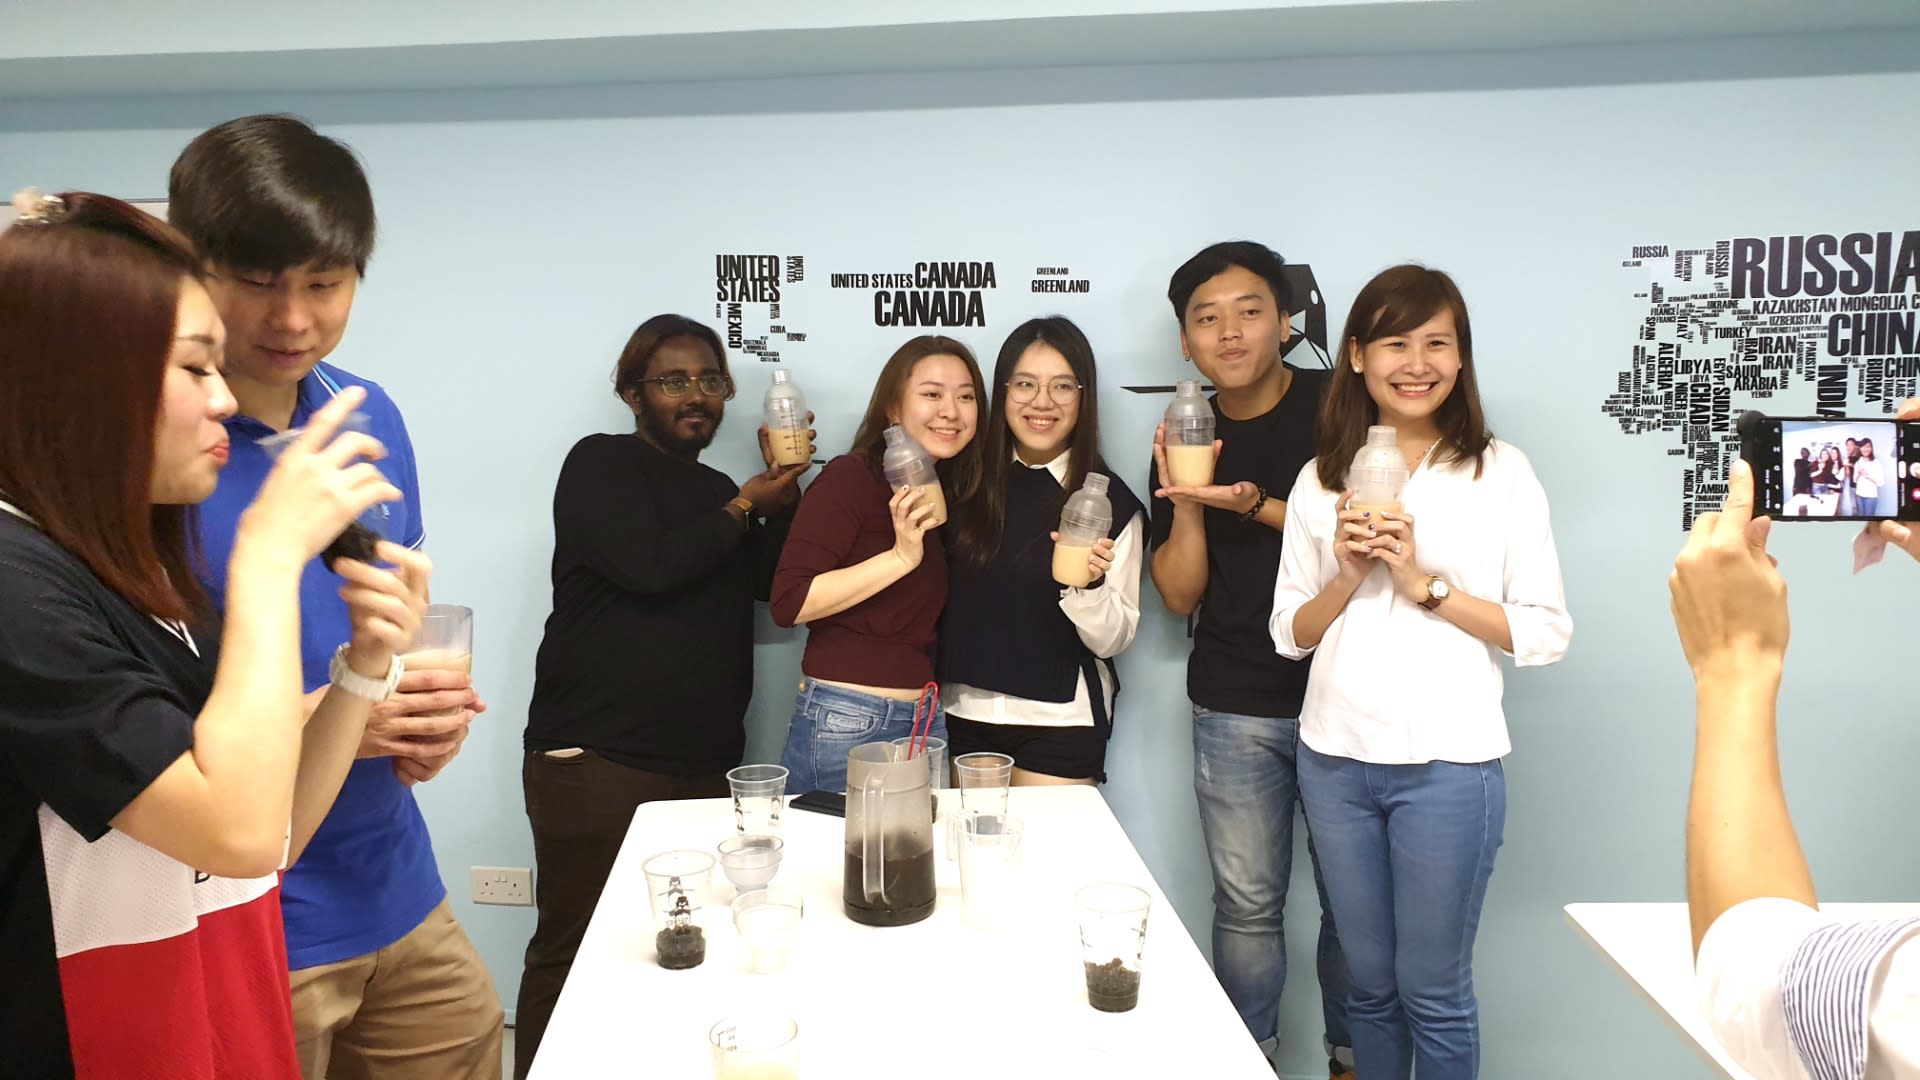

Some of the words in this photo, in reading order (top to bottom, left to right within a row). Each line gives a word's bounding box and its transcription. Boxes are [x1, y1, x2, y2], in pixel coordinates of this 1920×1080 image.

[1632, 245, 1669, 258] RUSSIA
[1705, 249, 1714, 275] FINLAND
[1714, 241, 1730, 278] RUSSIA
[716, 255, 780, 280] UNITED
[914, 262, 996, 289] CANADA
[1036, 267, 1069, 275] GREENLAND
[1674, 250, 1684, 278] NORWAY
[1683, 256, 1692, 281] SWEDEN
[1731, 231, 1920, 299] RUSSIA
[717, 279, 781, 302] STATES
[831, 273, 869, 288] UNITED
[872, 273, 913, 288] STATES
[1031, 279, 1090, 293] GREENLAND
[874, 291, 985, 327] CANADA
[1651, 307, 1676, 315] FRANCE
[1707, 300, 1739, 309] UKRAINE
[1753, 298, 1837, 314] KAZAKHSTAN
[1840, 294, 1908, 311] MONGOLIA
[728, 303, 742, 348] MEXICO
[770, 325, 786, 333] CUBA
[1645, 317, 1656, 340] SPAIN
[1676, 316, 1688, 340] ITALY
[1769, 314, 1822, 326] UZBEKISTAN
[1714, 327, 1752, 339] TURKEY
[1743, 338, 1758, 361] IRAQ
[1758, 336, 1797, 354] IRAN
[1646, 355, 1656, 384] ALGERIA
[1657, 343, 1674, 390] ALGERIA
[1675, 359, 1712, 374] LIBYA
[1713, 358, 1726, 386] EGYPT
[1726, 364, 1761, 379] SAUDI
[1763, 355, 1793, 370] IRAN
[1805, 341, 1817, 381] PAKISTAN
[1734, 377, 1778, 391] ARABIA
[1865, 359, 1883, 403] BURMA
[1895, 379, 1906, 397] LAOS
[1907, 378, 1916, 399] VIETN
[1642, 395, 1663, 405] MALI
[1674, 383, 1688, 410] NIGER
[1689, 383, 1711, 425] CHAD
[1883, 379, 1894, 413] THAILAND
[1625, 408, 1643, 417] MALI
[1662, 411, 1687, 419] NIGERIA
[1712, 387, 1730, 432] SUDAN
[1726, 443, 1740, 451] KEN
[1683, 469, 1694, 499] ANGOLA
[1695, 484, 1729, 494] ZAMBIA
[1682, 502, 1693, 531] NAMIBIA
